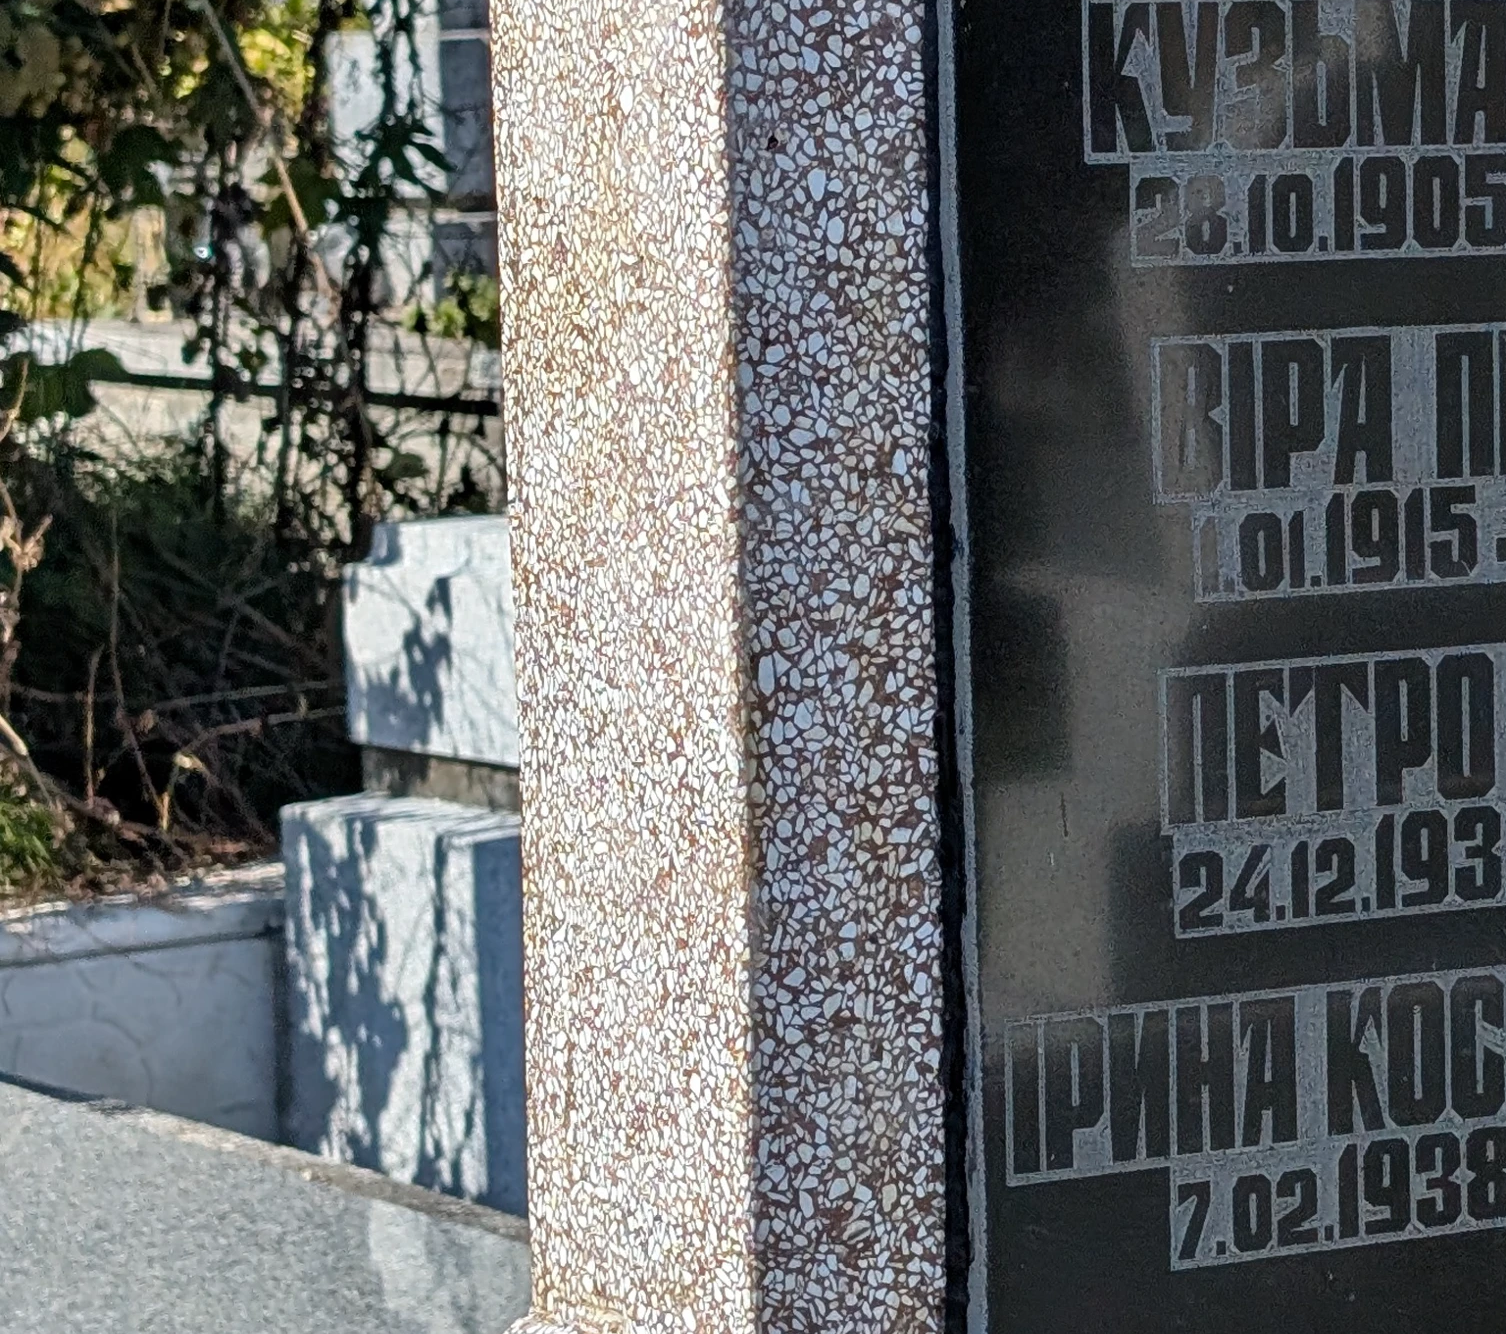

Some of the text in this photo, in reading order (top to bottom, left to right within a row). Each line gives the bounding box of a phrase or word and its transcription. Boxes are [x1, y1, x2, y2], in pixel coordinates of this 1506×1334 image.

[1160, 336, 1393, 498] ВІРА
[1166, 651, 1496, 826] ПЕТРО
[1011, 1001, 1299, 1175] ІРИНА
